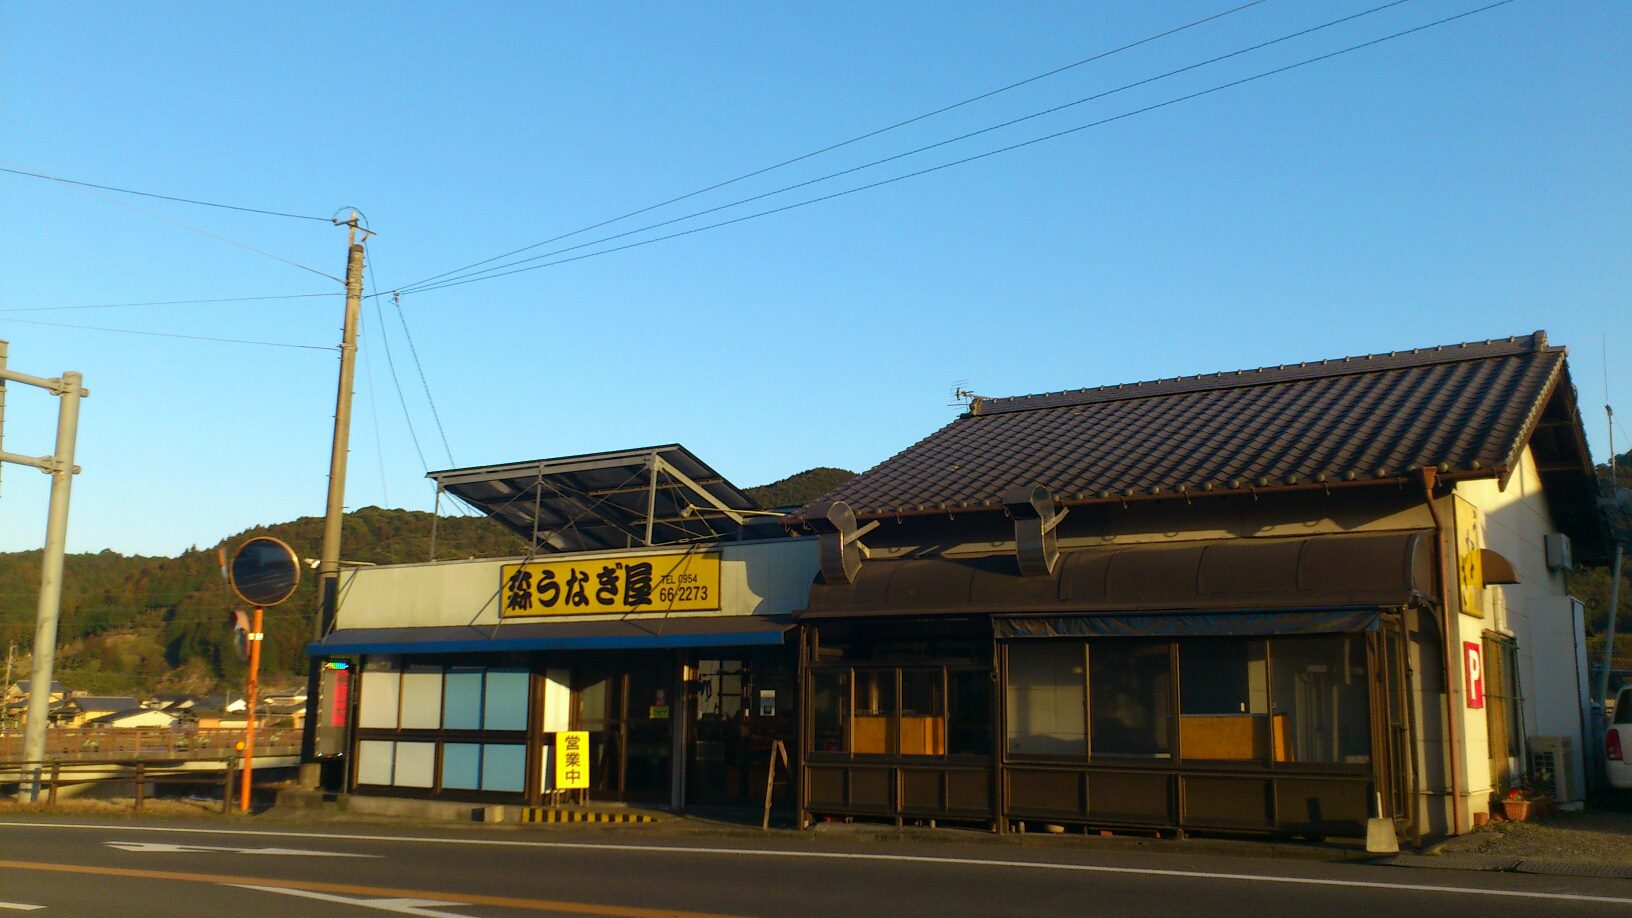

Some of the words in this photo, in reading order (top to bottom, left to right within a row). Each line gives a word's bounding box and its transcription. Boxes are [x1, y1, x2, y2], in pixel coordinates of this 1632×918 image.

[661, 574, 676, 584] TEL
[678, 573, 697, 584] 0954
[1468, 648, 1480, 700] P
[565, 735, 580, 784] 営業中
